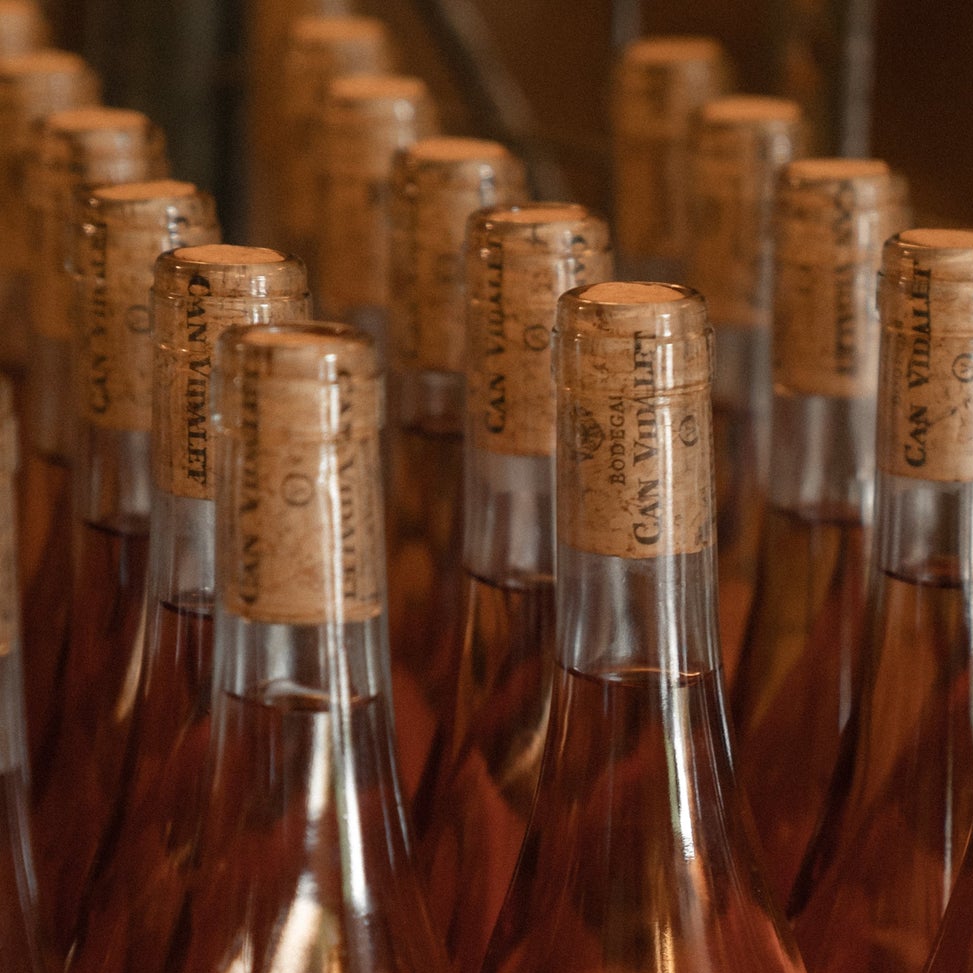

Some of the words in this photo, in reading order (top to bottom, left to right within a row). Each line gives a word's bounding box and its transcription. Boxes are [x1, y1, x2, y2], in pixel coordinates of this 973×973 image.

[187, 274, 212, 343] CAN
[907, 258, 933, 390] VIDALET
[187, 355, 212, 485] VIDALET
[904, 404, 929, 468] CAN
[632, 477, 662, 546] CAN
